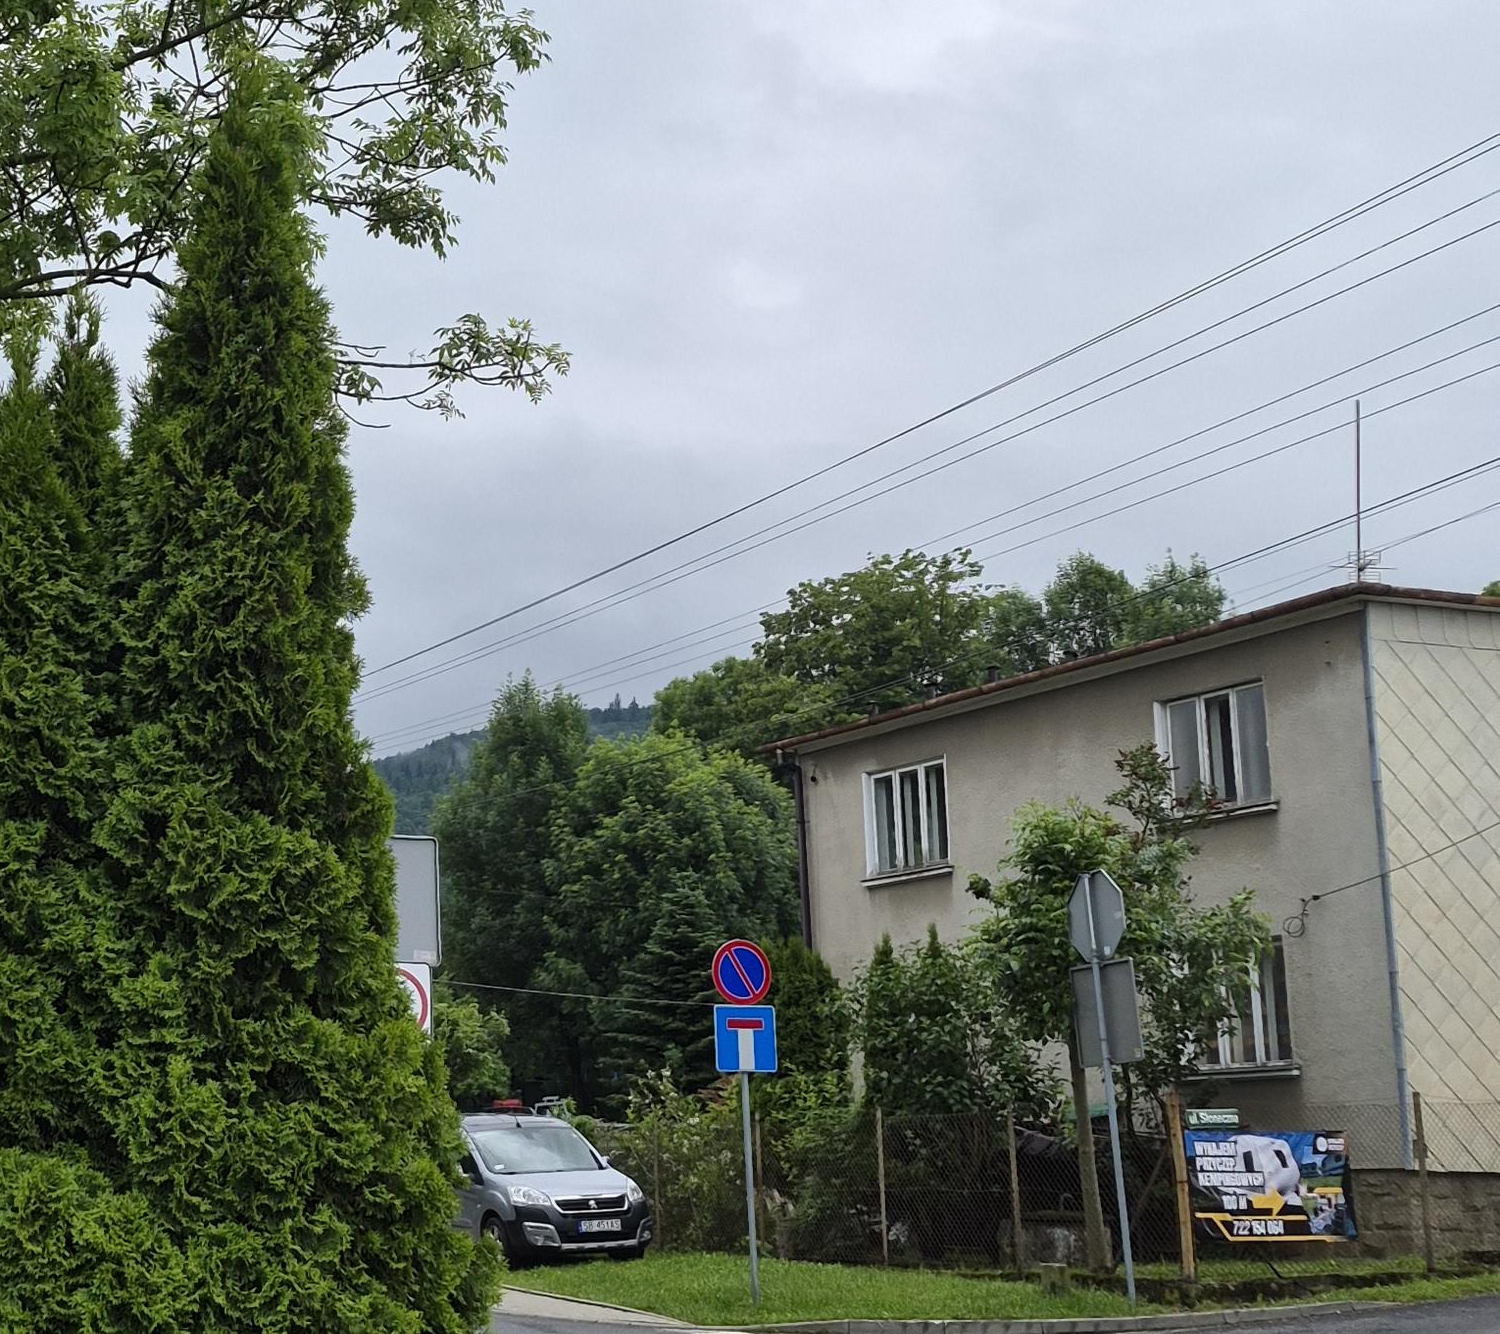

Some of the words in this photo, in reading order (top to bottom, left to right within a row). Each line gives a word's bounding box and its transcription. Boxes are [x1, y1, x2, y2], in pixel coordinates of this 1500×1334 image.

[1194, 1141, 1236, 1156] WYNAJEM
[1196, 1156, 1235, 1171] PRZYCZEP
[1233, 1220, 1250, 1235] 722
